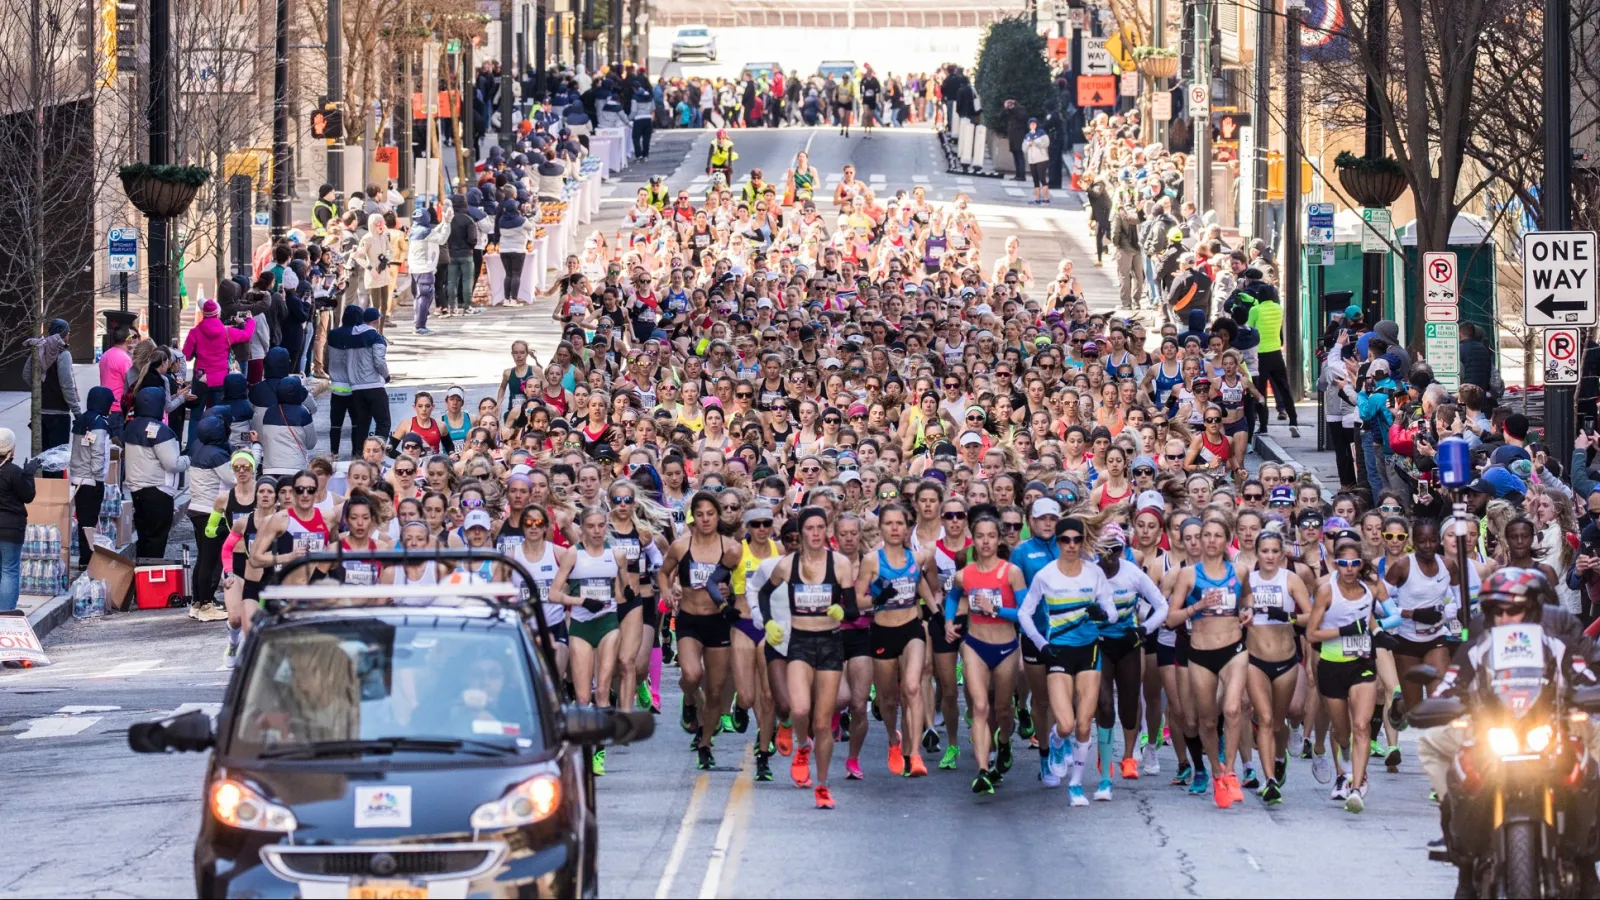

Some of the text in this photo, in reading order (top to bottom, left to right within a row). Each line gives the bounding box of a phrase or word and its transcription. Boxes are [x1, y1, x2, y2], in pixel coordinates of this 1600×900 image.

[1088, 41, 1104, 49] ONE
[1088, 52, 1106, 60] WAY
[1364, 210, 1371, 220] 2
[1532, 240, 1588, 262] ONE
[1532, 268, 1588, 290] WAY
[1428, 325, 1435, 336] 2
[0, 636, 32, 648] NO
[1512, 697, 1525, 708] 77
